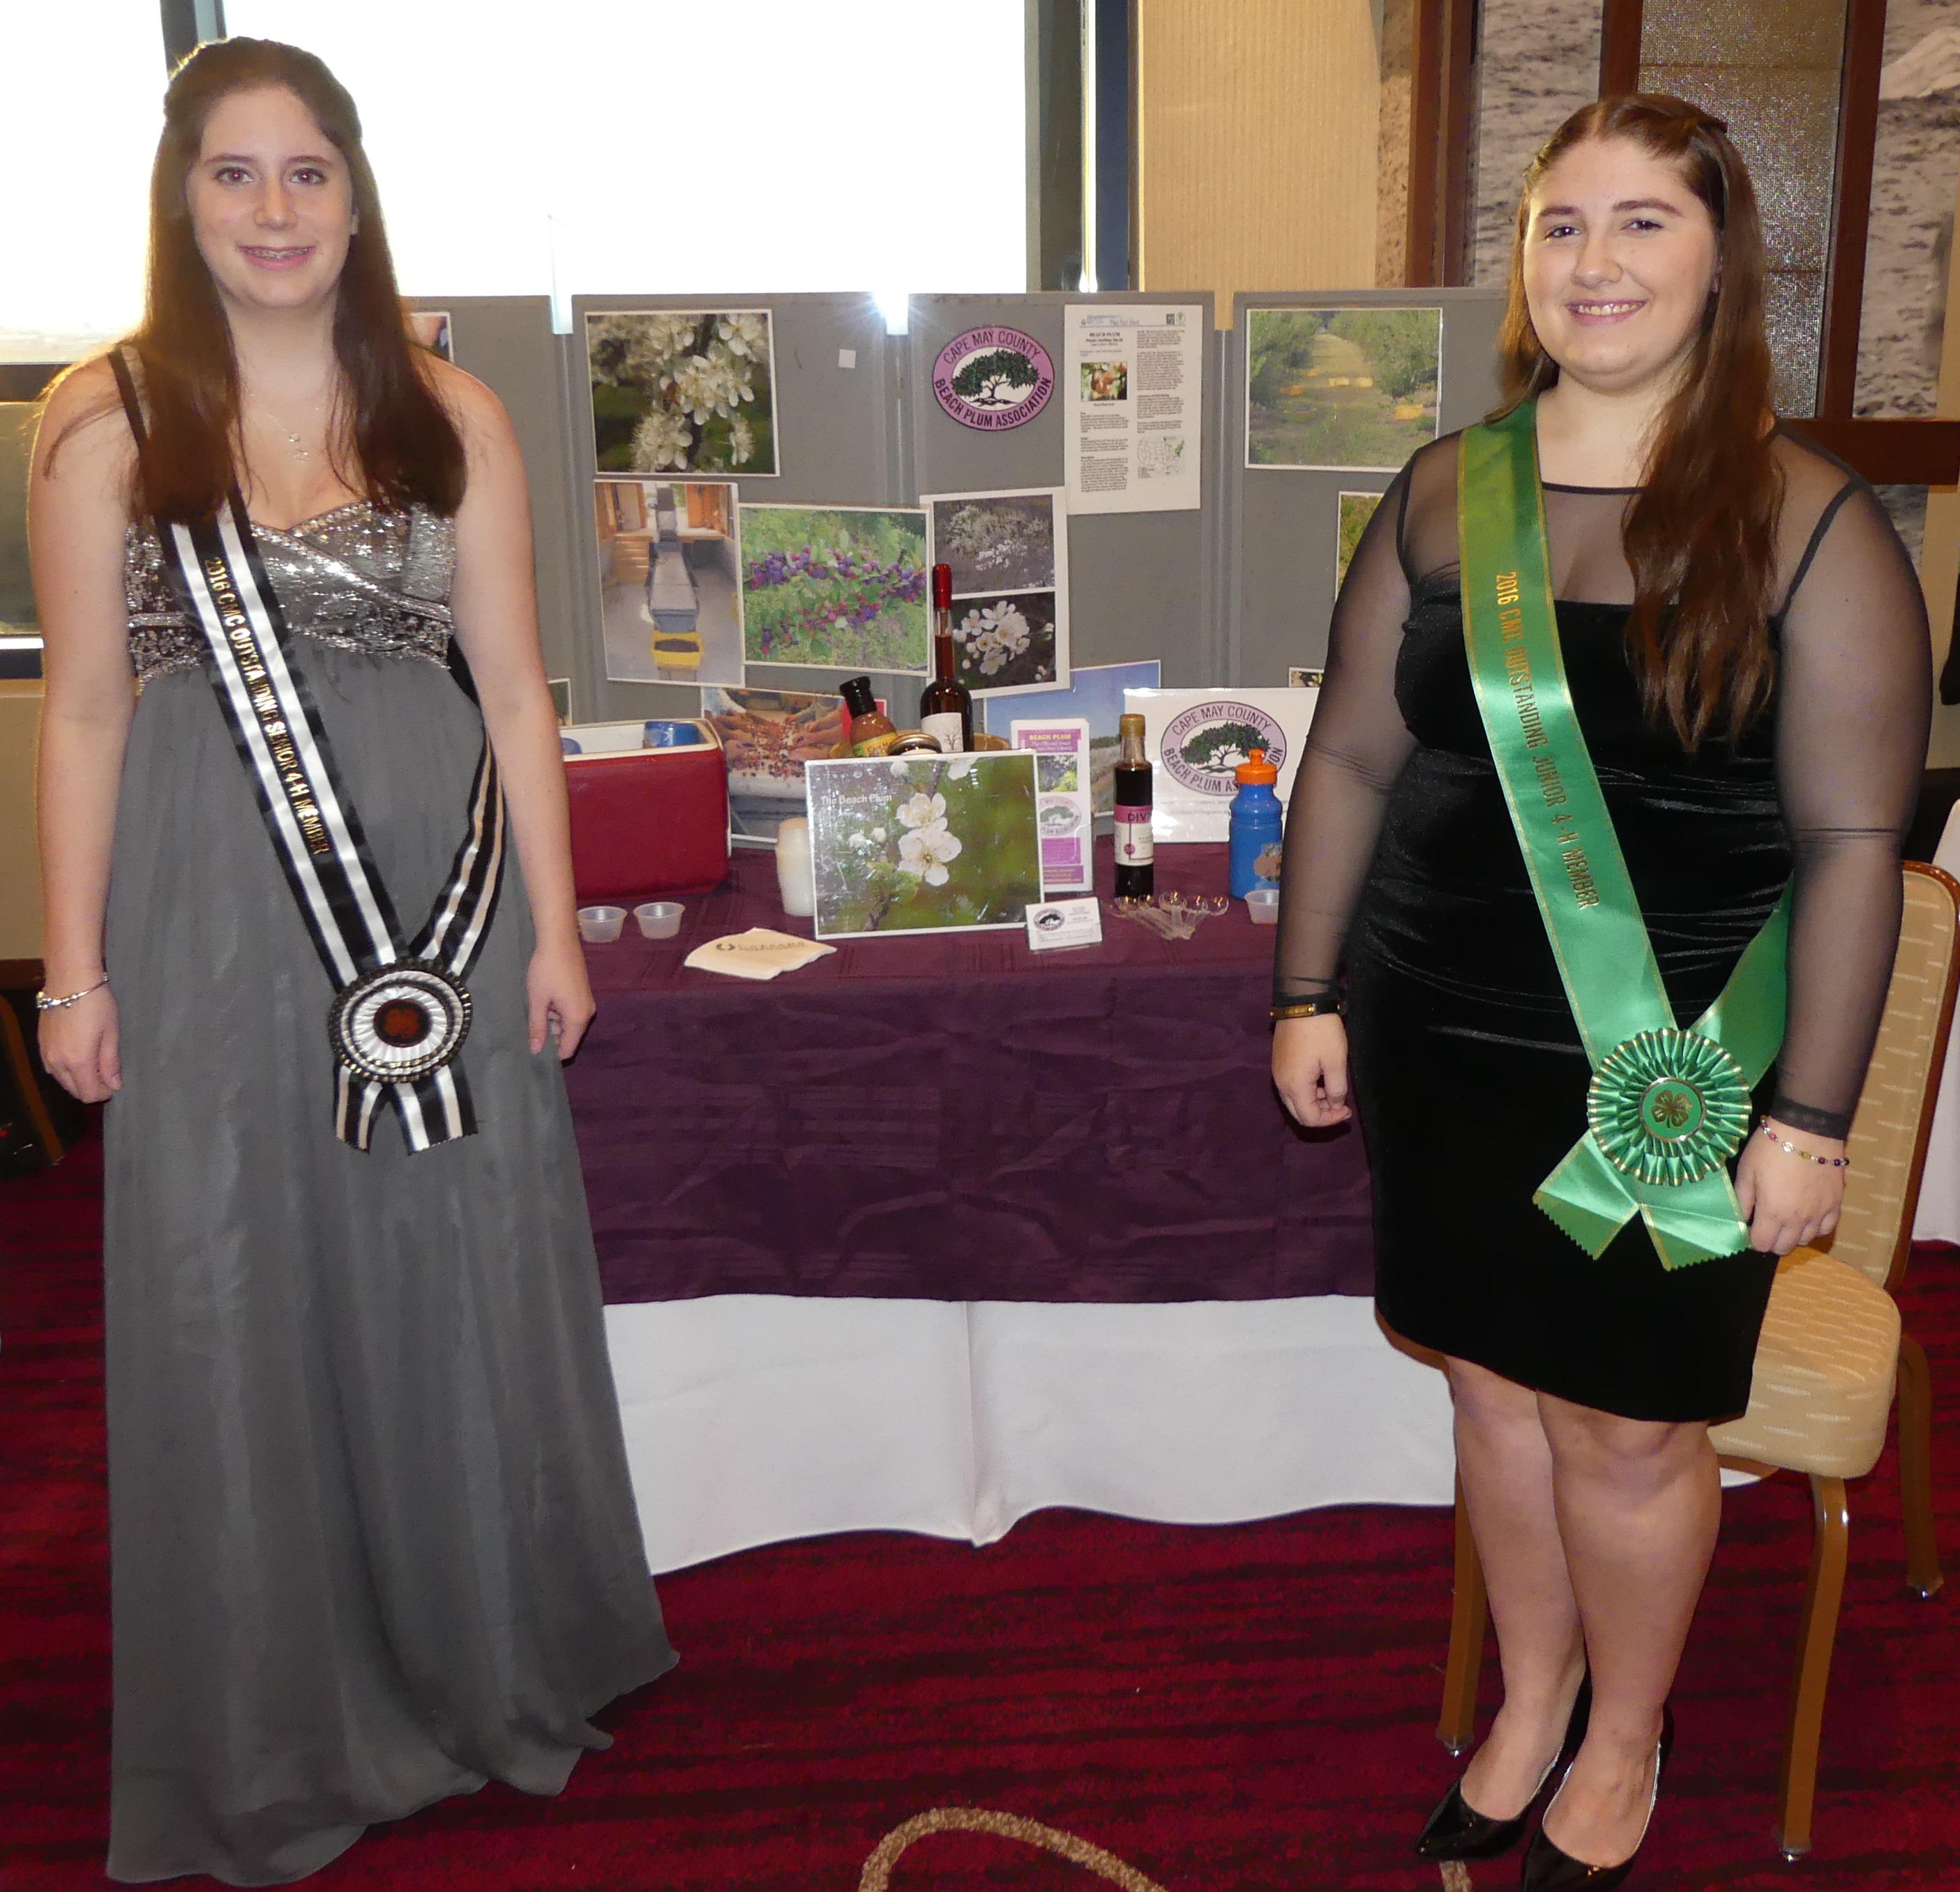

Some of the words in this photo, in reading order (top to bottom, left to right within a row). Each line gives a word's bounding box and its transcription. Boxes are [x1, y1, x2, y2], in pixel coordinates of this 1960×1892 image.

[944, 338, 971, 364] CAPE
[972, 331, 994, 345] MAY
[999, 331, 1041, 359] COUNTY
[935, 378, 964, 416] BEACH
[963, 408, 992, 427] PLUM
[996, 377, 1051, 427] ASSOCIATION
[1496, 570, 1519, 605] 2016
[1500, 607, 1524, 644] CMC
[205, 557, 231, 591] 2016
[218, 592, 245, 627] CMC
[264, 720, 298, 771] SENIOR
[1505, 646, 1549, 750] OUTSTANDING
[1172, 711, 1200, 736] CAPE
[1200, 705, 1223, 719] MAY
[1228, 706, 1272, 731] COUNTY
[1164, 748, 1191, 780] BEACH
[1190, 775, 1221, 792] PLUM
[1532, 755, 1567, 808] JUNIOR
[820, 796, 837, 805] The
[838, 795, 868, 805] Beach
[868, 794, 893, 803] Plum
[1562, 847, 1599, 910] MEMBER
